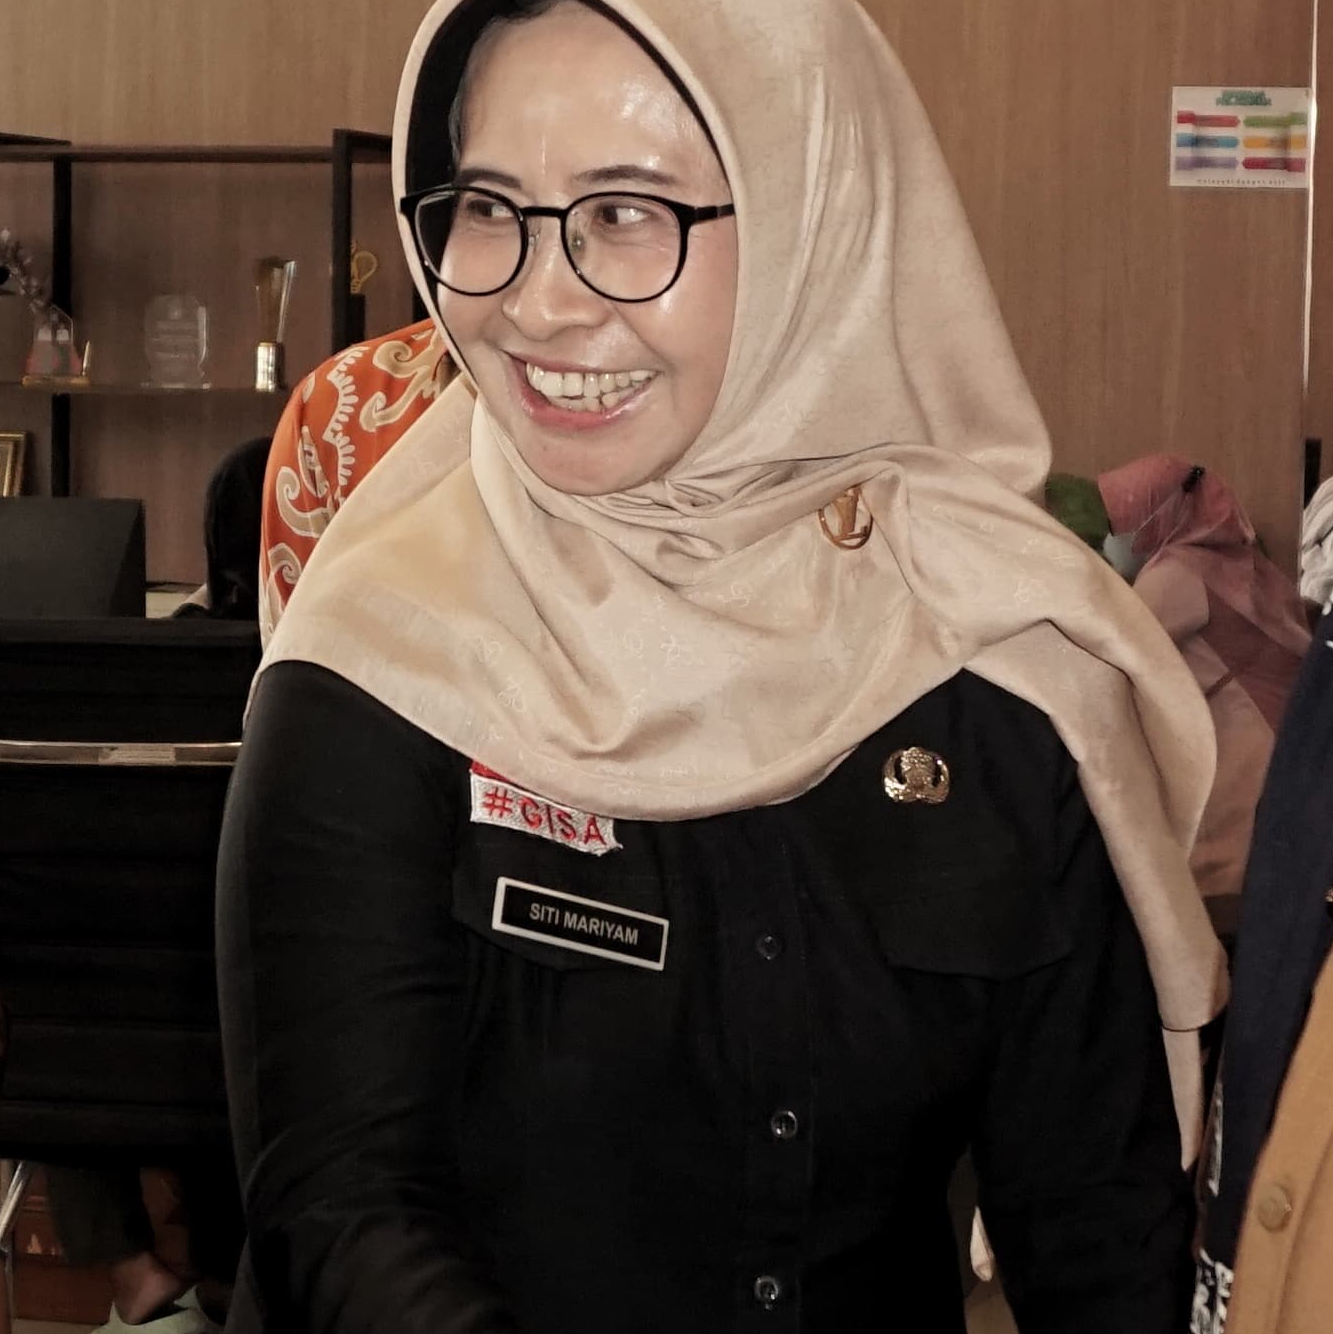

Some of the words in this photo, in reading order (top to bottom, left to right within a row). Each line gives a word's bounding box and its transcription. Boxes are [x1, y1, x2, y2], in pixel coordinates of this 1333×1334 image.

[482, 786, 607, 846] #GISA
[529, 902, 560, 924] SITI
[564, 911, 639, 946] MARIYAM
